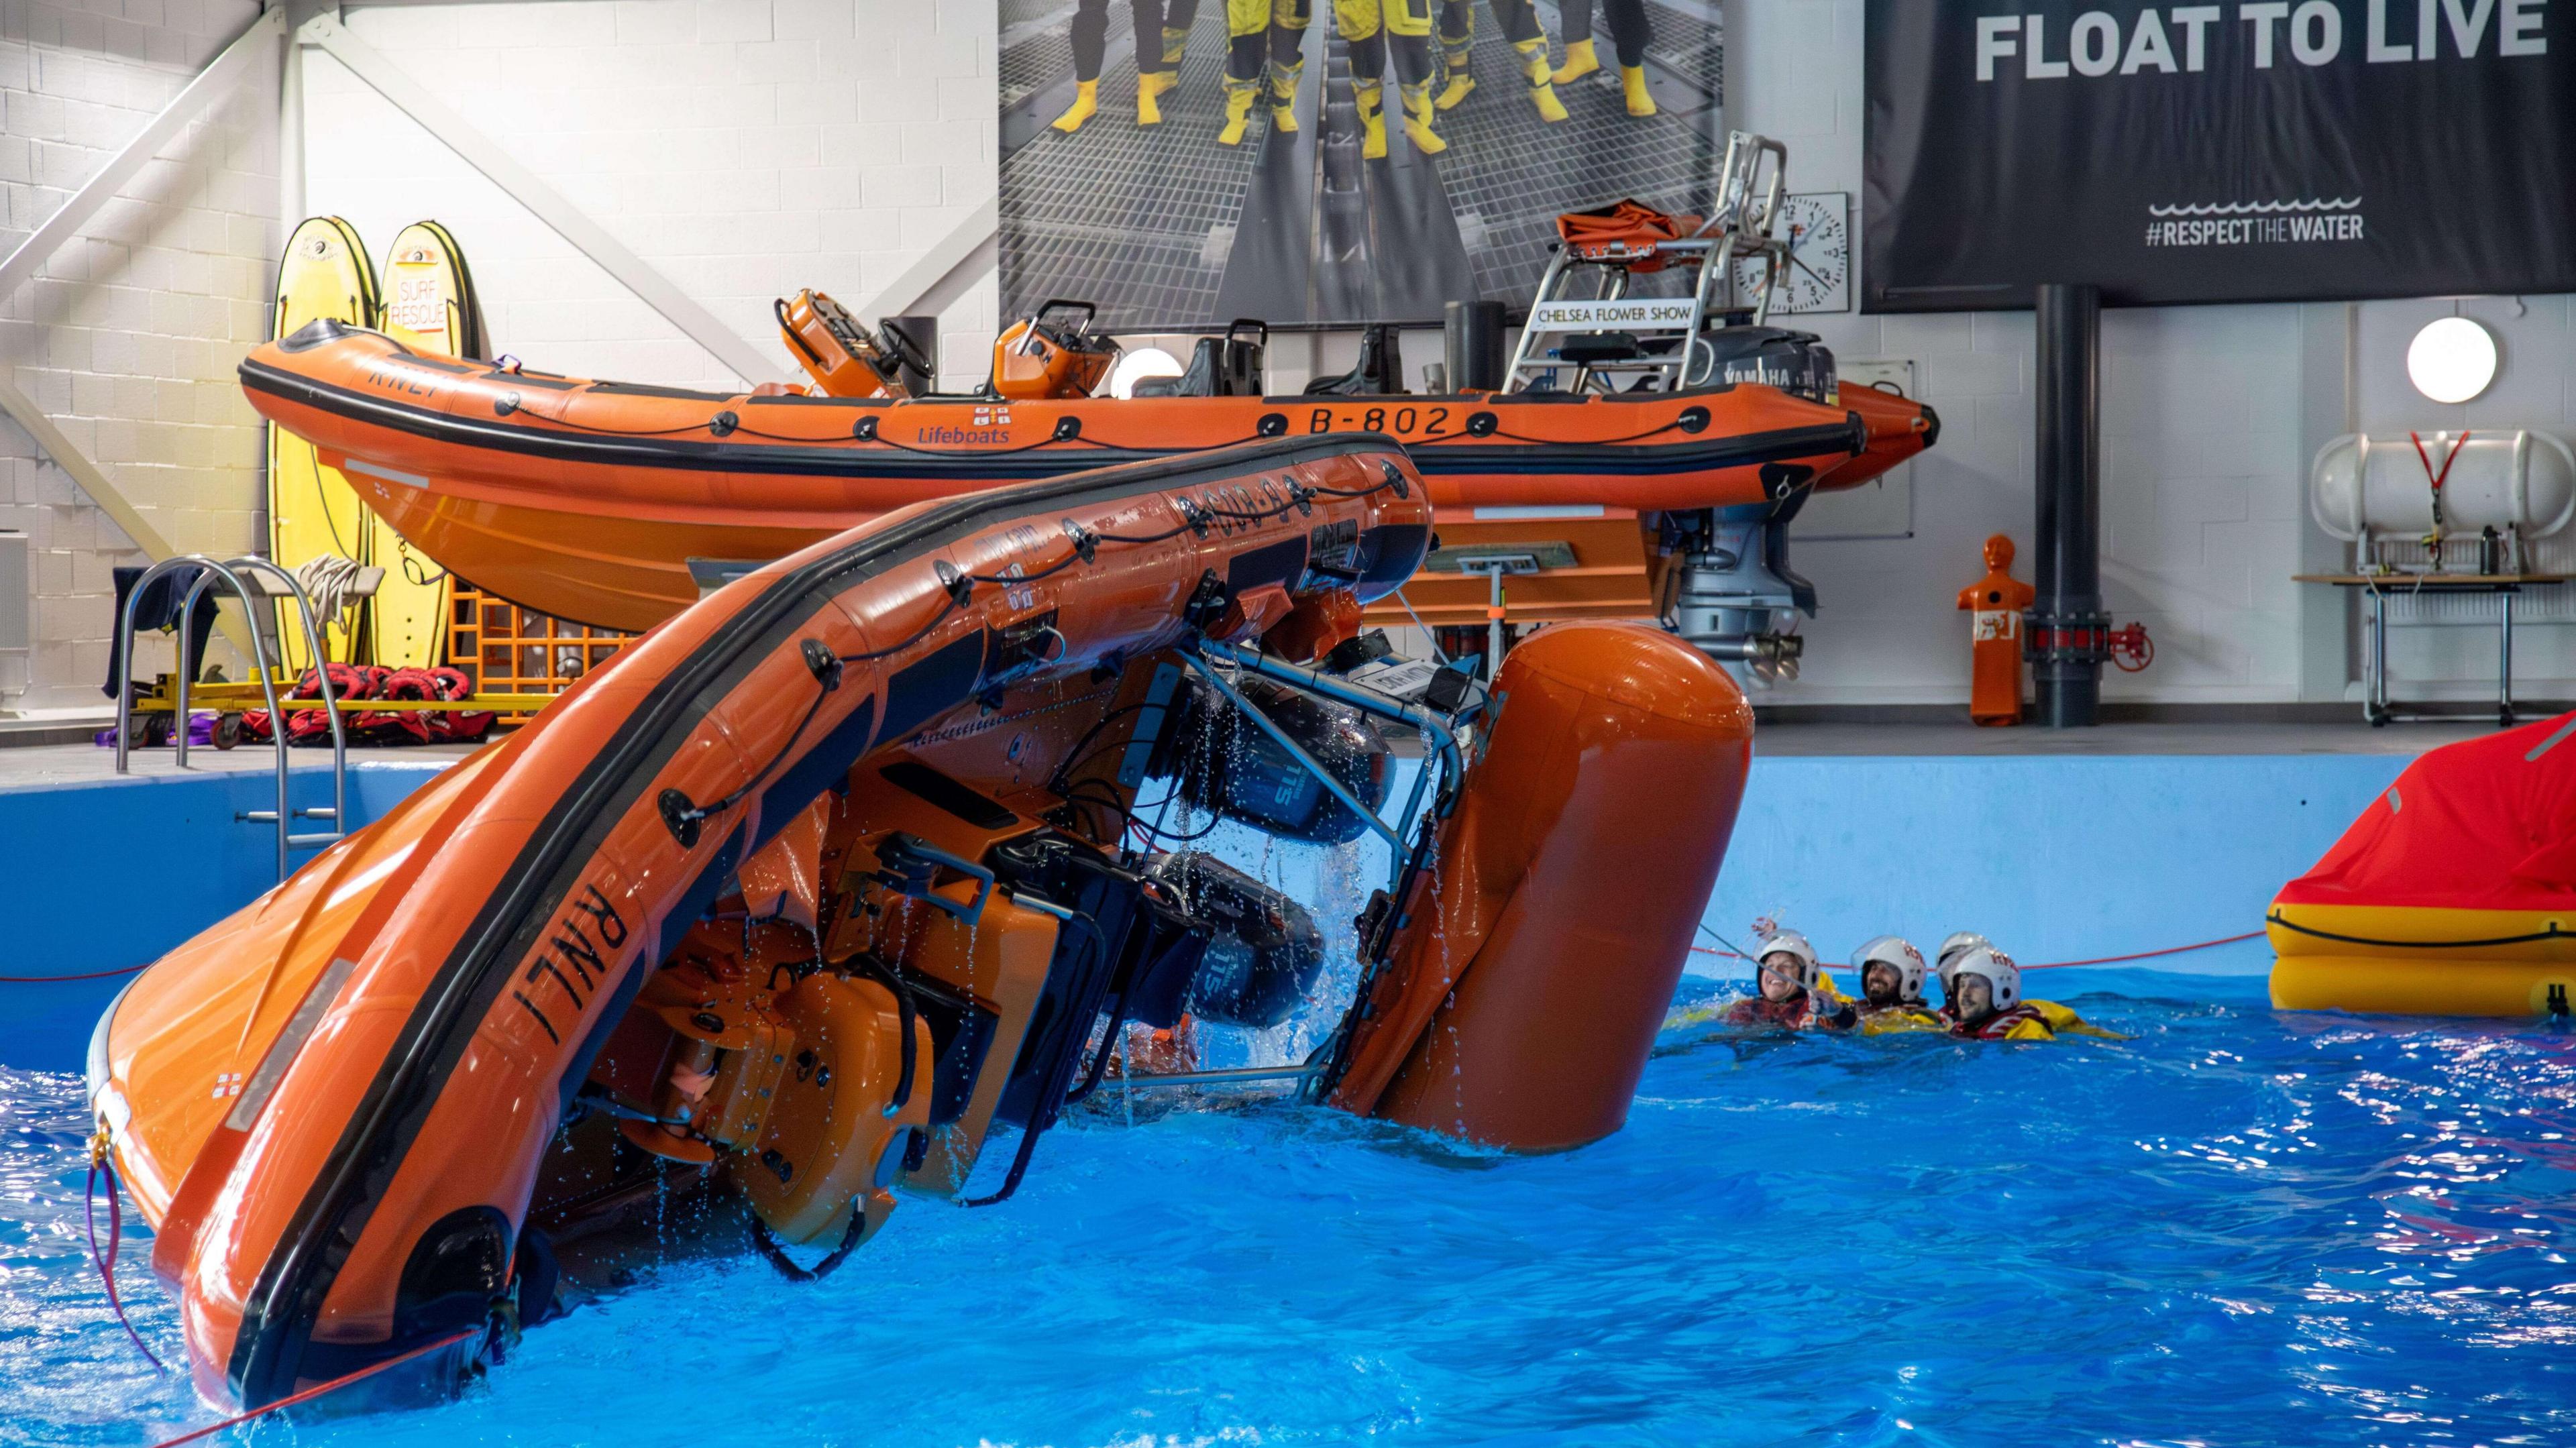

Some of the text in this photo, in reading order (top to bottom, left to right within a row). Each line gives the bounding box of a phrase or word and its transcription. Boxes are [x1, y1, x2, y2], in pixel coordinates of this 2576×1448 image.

[1976, 0, 2548, 81] FLOAT TO LIVE
[1825, 227, 1833, 237] 2
[1833, 247, 1839, 258] 3
[400, 278, 437, 302] SURF
[1787, 293, 1794, 303] 6
[1810, 286, 1817, 296] 5
[390, 303, 445, 326] RESCUE
[1538, 307, 1691, 323] CHELSEA FLOWER SHOW
[1724, 368, 1790, 387] YAMAHA
[1309, 407, 1448, 434] B-802
[918, 426, 1010, 444] Lifeboats
[513, 883, 628, 1046] RNLI
